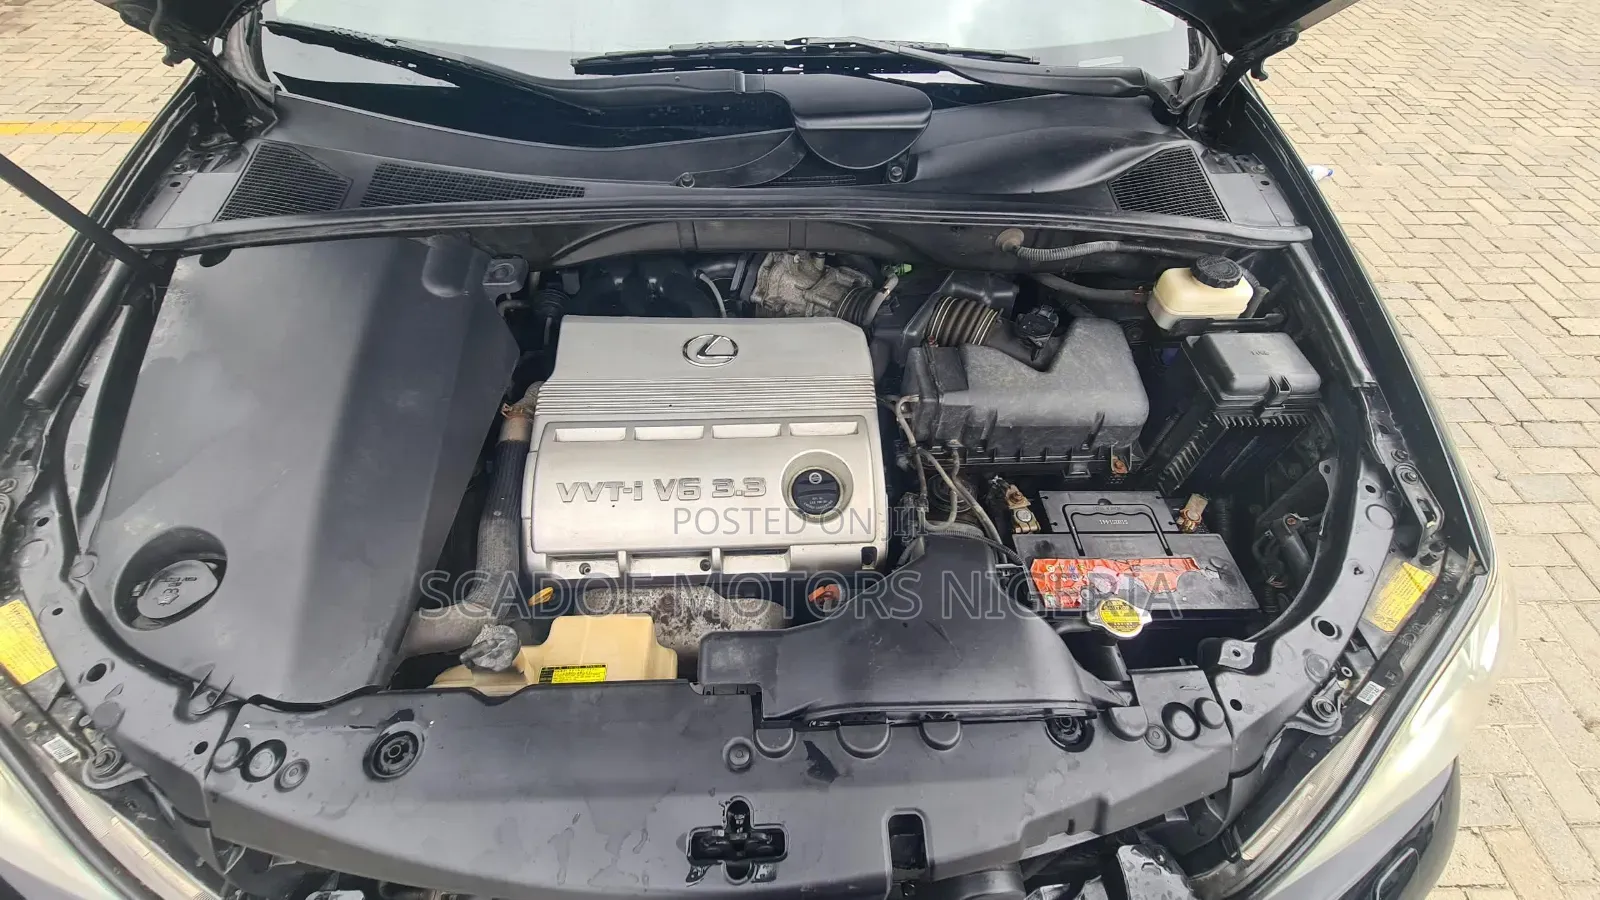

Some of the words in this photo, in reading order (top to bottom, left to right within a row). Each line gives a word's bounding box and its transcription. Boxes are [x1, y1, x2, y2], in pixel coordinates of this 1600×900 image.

[556, 480, 643, 502] VVT-i
[653, 478, 701, 501] V6
[712, 477, 767, 498] 3.3
